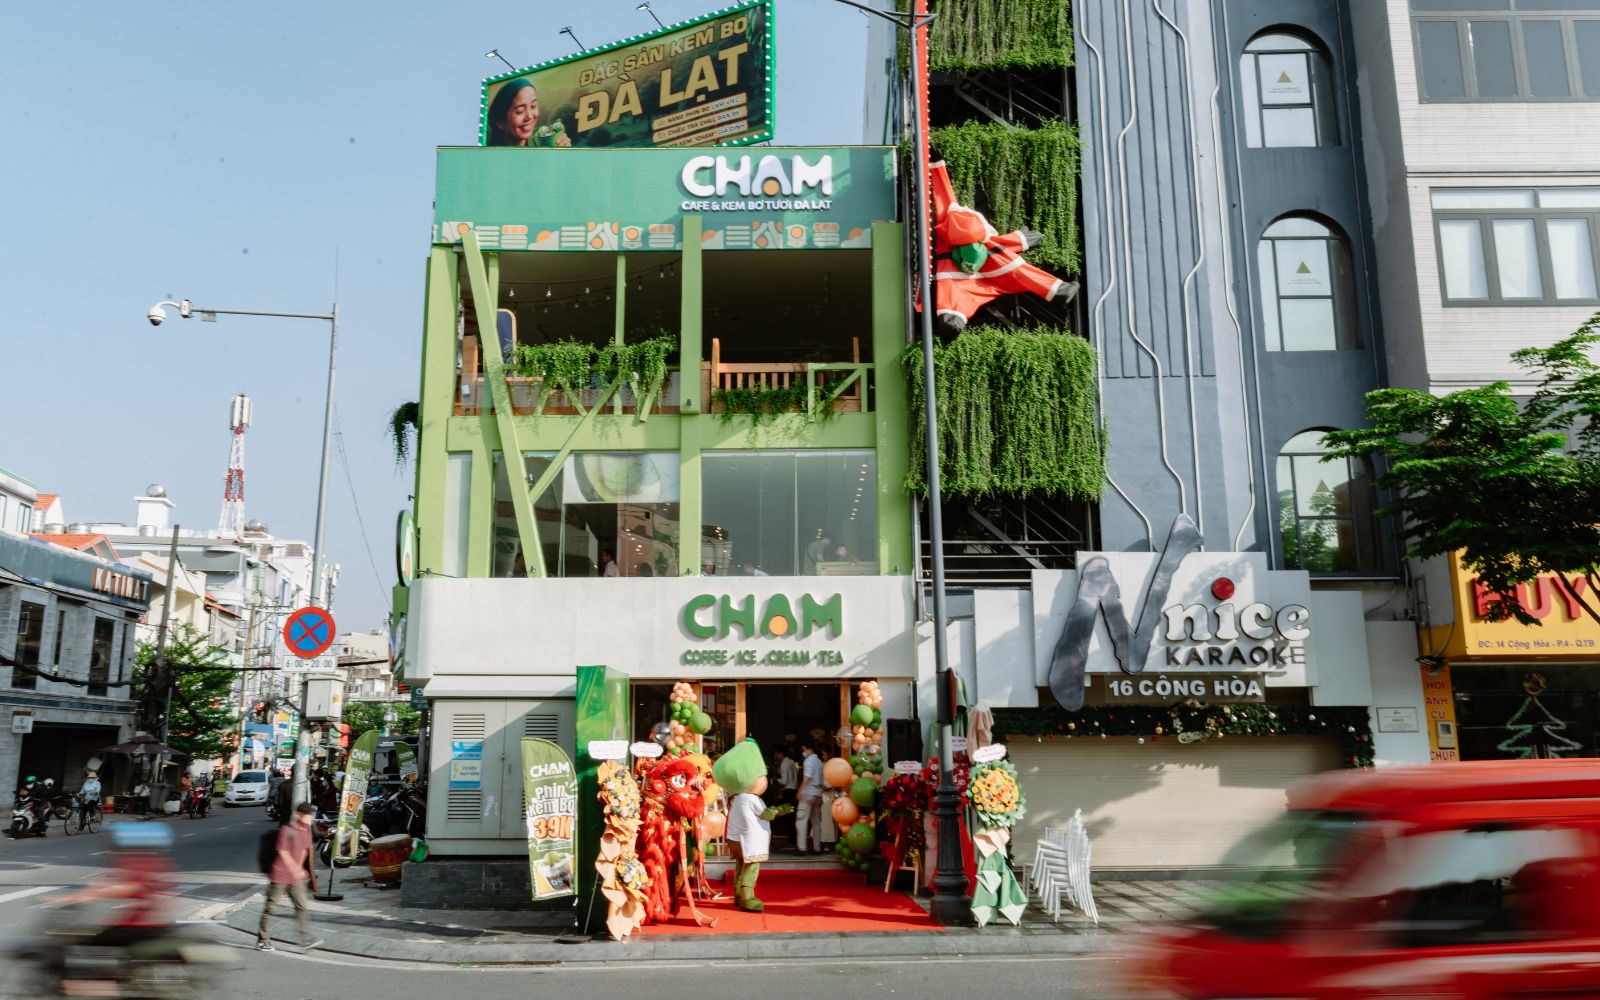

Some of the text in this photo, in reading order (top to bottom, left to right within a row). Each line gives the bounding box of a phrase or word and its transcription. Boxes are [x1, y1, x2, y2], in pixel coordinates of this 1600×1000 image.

[671, 27, 715, 57] KEM
[574, 42, 748, 133] ĐÀ LẠT
[681, 154, 833, 197] CHAM
[711, 201, 720, 210] &
[721, 201, 746, 210] KEM
[683, 593, 843, 638] CHAM
[1165, 646, 1307, 666] KARAOKE
[1496, 640, 1504, 648] 14
[682, 649, 844, 666] COFFEE ICE CREAM TEA
[1108, 675, 1263, 699] 16 CỘNG HÒA
[529, 762, 570, 778] CHAM
[533, 814, 574, 840] 39K
